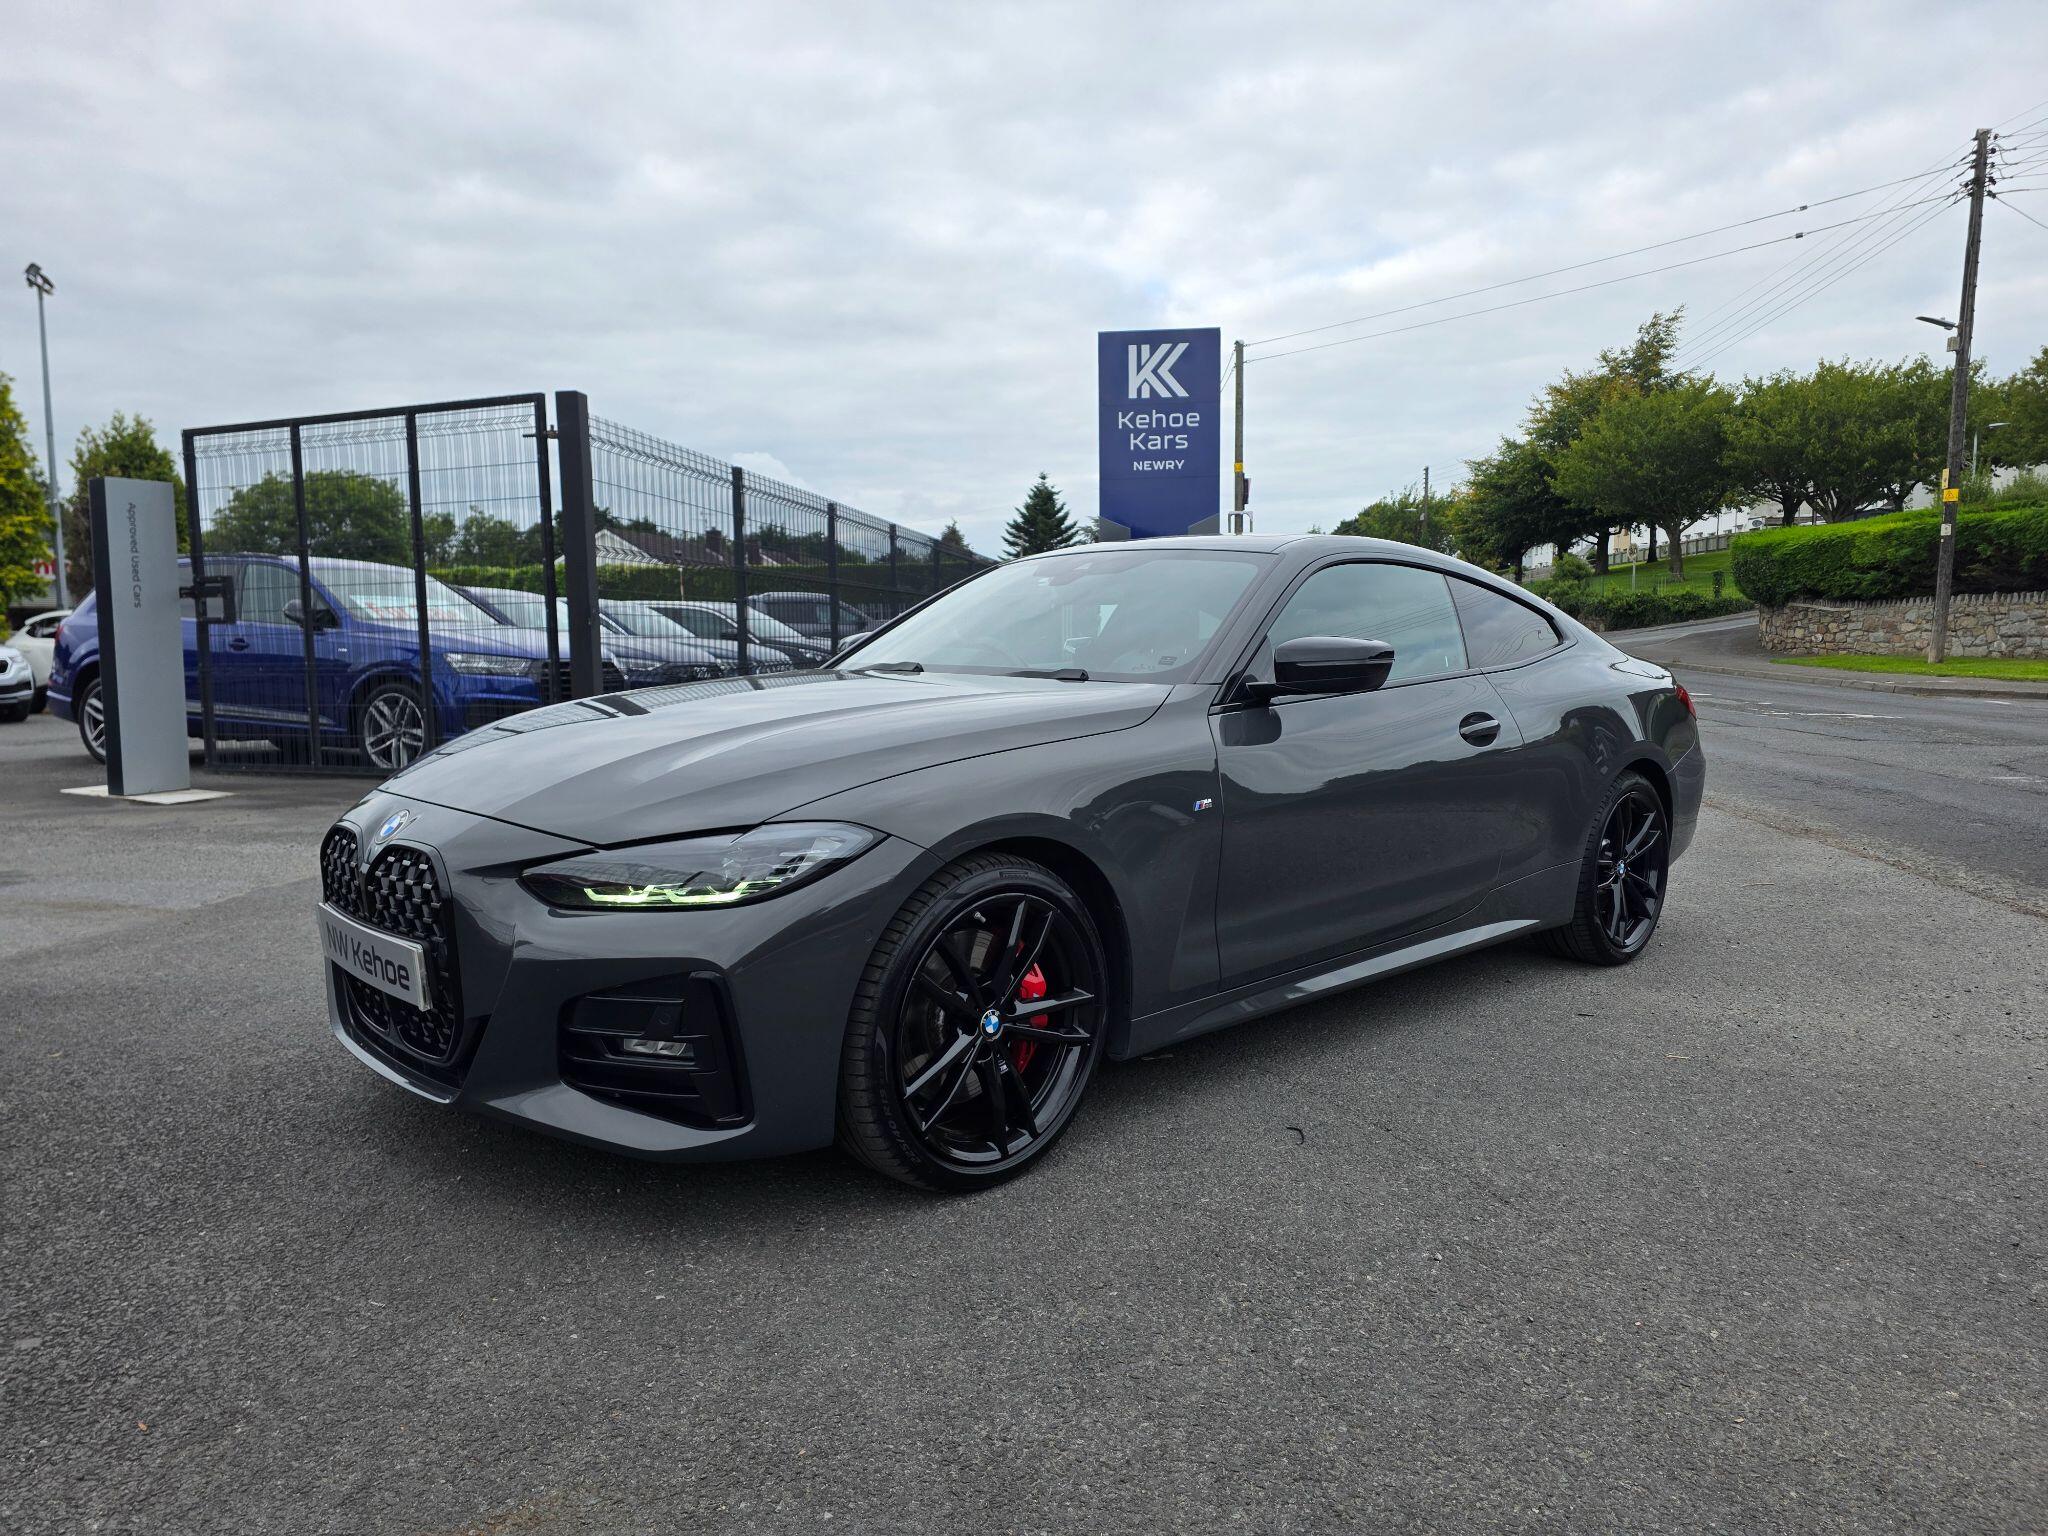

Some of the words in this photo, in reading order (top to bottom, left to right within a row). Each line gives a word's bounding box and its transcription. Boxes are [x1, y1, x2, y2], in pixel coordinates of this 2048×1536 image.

[1118, 410, 1200, 429] Kehoe
[1130, 433, 1189, 450] Kars
[1133, 460, 1185, 471] NEWRY
[127, 502, 139, 553] Approved
[130, 556, 140, 582] Used
[133, 584, 141, 608] Cars
[351, 937, 410, 991] Kehoe
